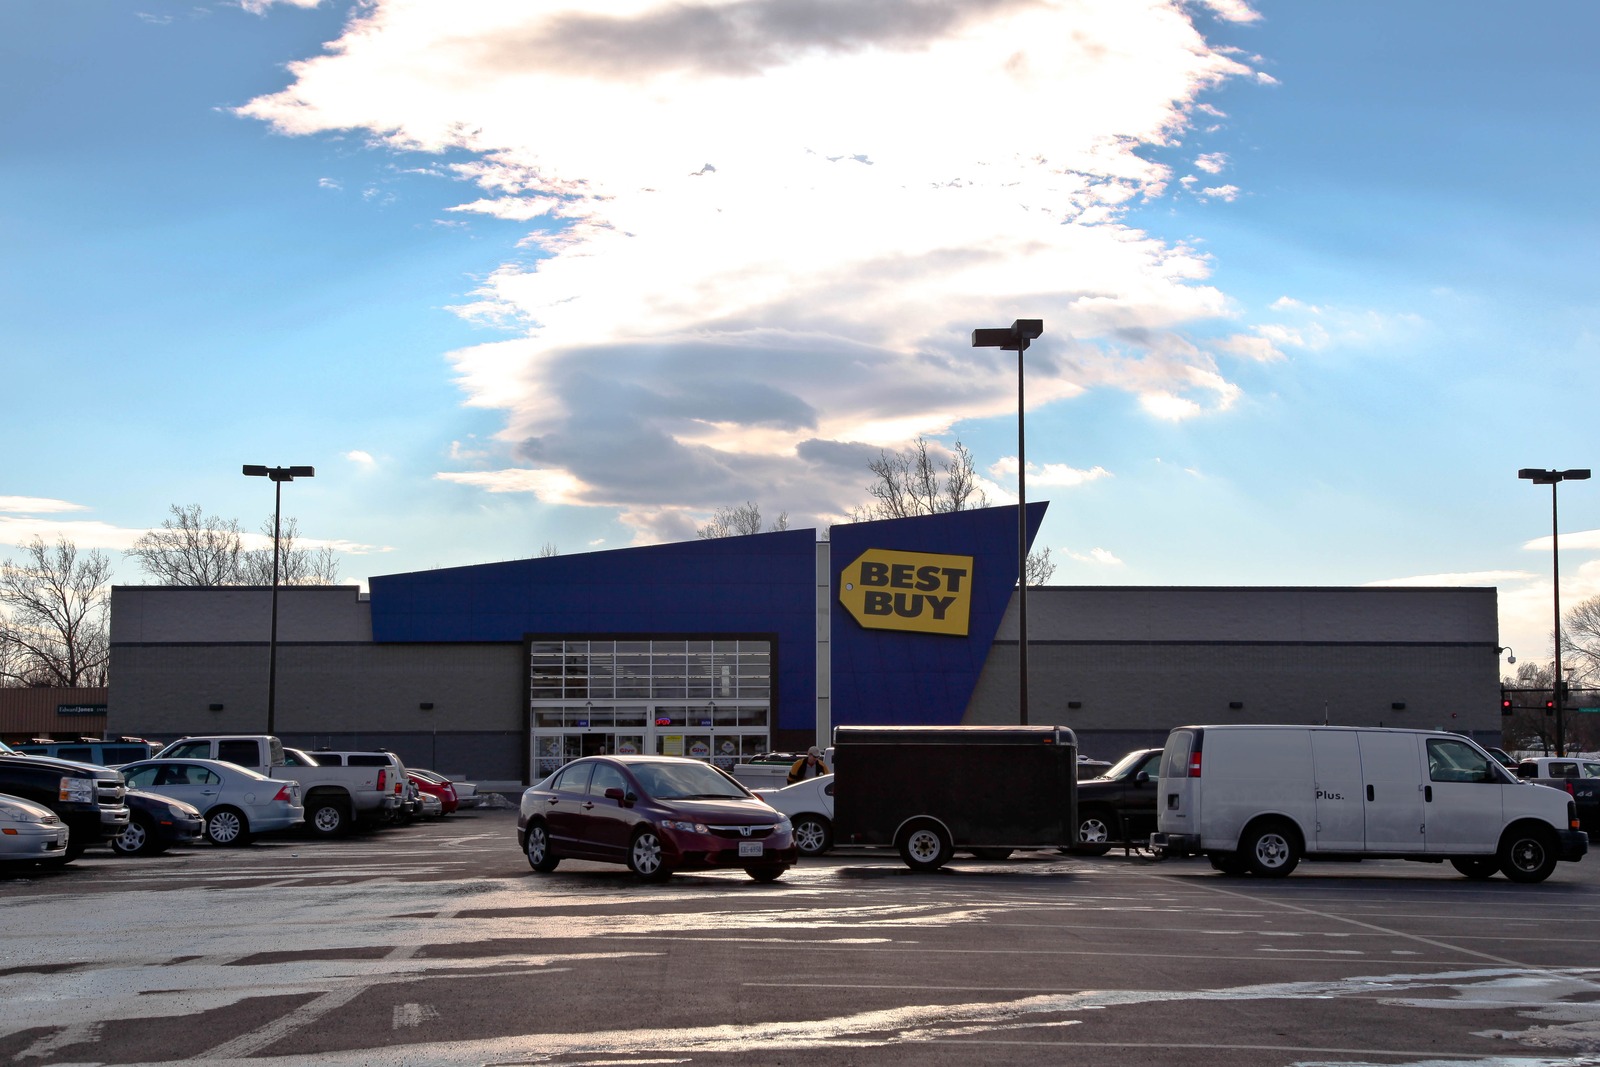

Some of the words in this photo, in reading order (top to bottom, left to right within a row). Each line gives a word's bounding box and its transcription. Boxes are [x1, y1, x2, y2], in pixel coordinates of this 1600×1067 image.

[860, 561, 967, 592] BEST
[864, 590, 957, 620] BUY
[1316, 790, 1345, 800] Plus.
